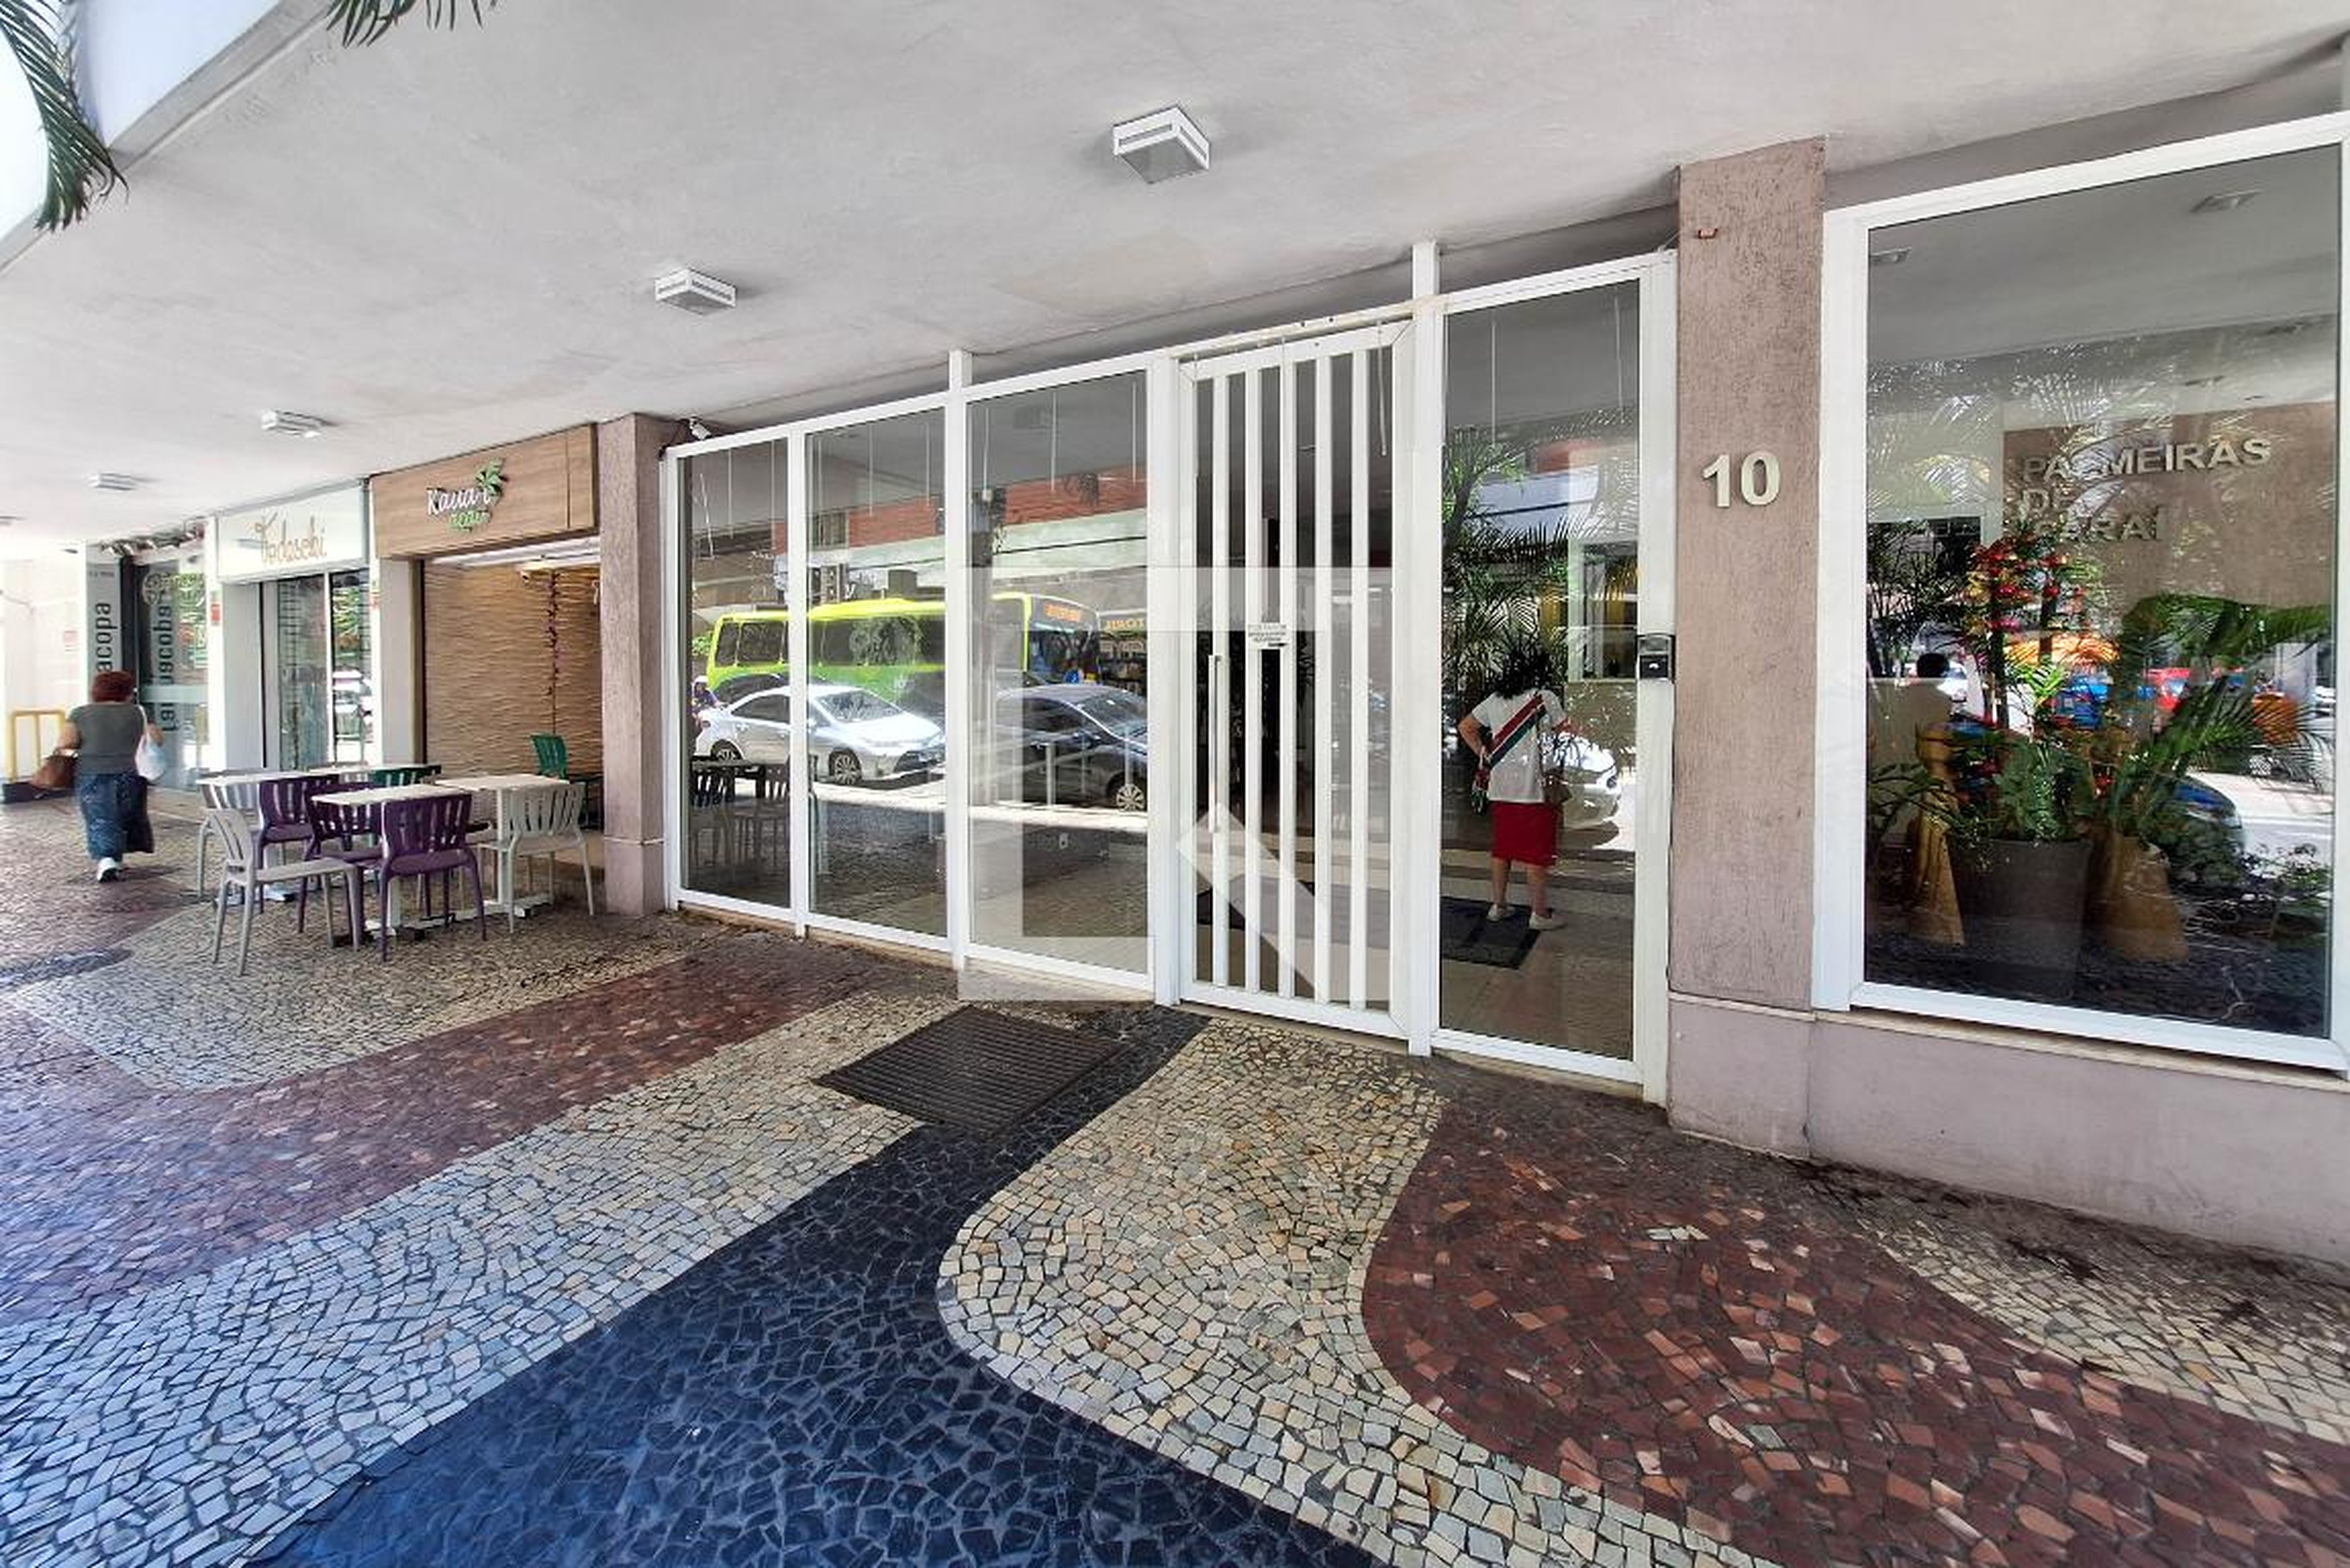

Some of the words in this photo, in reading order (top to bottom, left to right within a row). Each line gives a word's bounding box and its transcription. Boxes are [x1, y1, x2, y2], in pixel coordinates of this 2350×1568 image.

[1703, 450, 1781, 508] 10
[2022, 437, 2271, 485] PAMEIRAS
[95, 602, 118, 673] acopa
